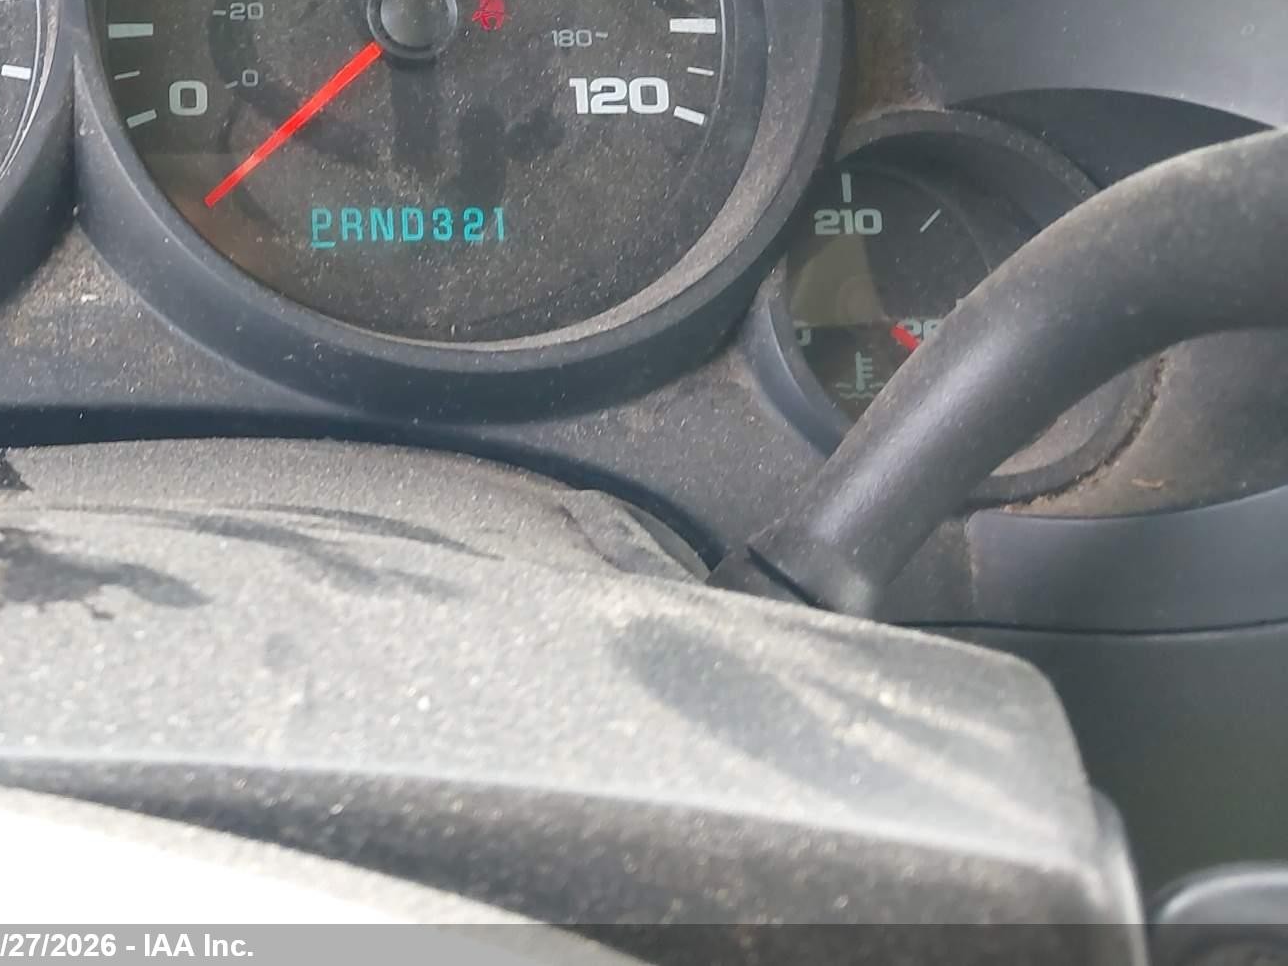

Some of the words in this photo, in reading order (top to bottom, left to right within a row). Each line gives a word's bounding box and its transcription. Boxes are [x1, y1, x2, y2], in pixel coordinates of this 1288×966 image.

[229, 1, 264, 21] 20
[551, 28, 593, 48] 180
[241, 69, 259, 88] 0
[168, 79, 208, 116] 0
[569, 77, 669, 115] 120
[814, 208, 882, 235] 210
